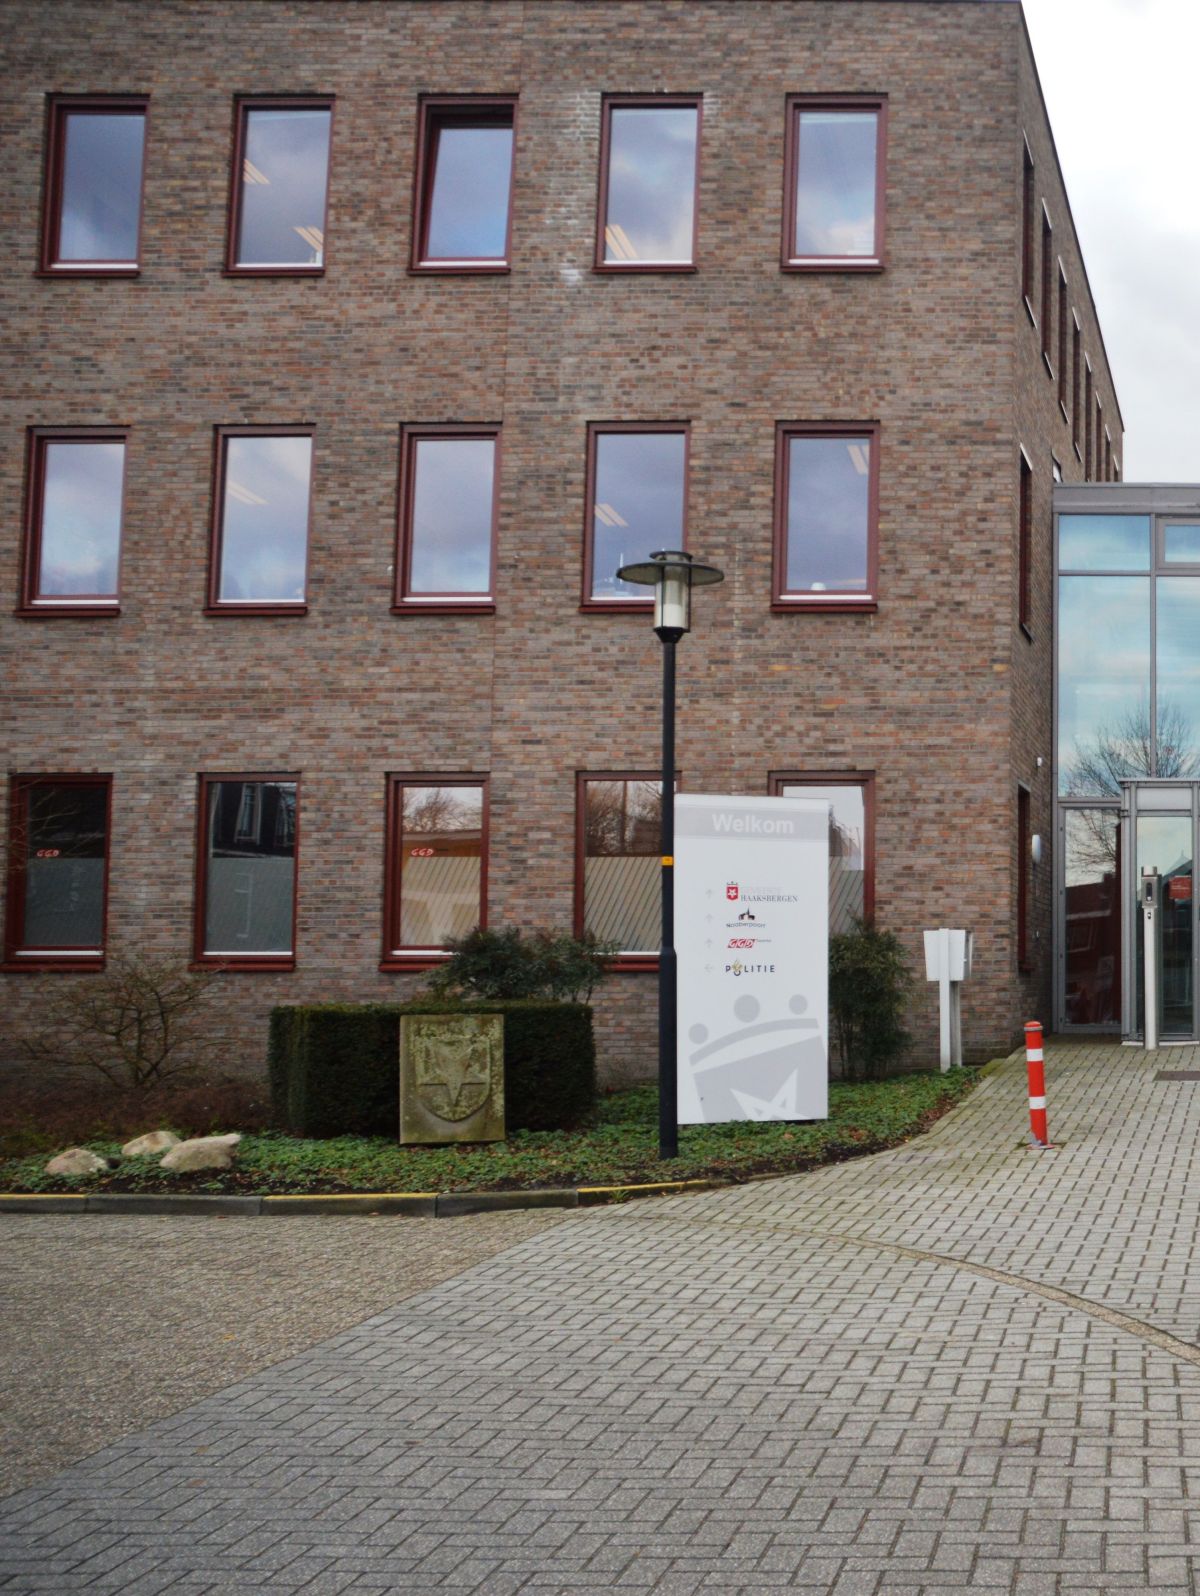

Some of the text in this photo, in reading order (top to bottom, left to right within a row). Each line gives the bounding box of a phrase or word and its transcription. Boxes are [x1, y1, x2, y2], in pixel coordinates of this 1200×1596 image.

[711, 813, 795, 834] Welkom
[741, 894, 798, 903] HAAKSBERGEN
[728, 938, 755, 949] GGD
